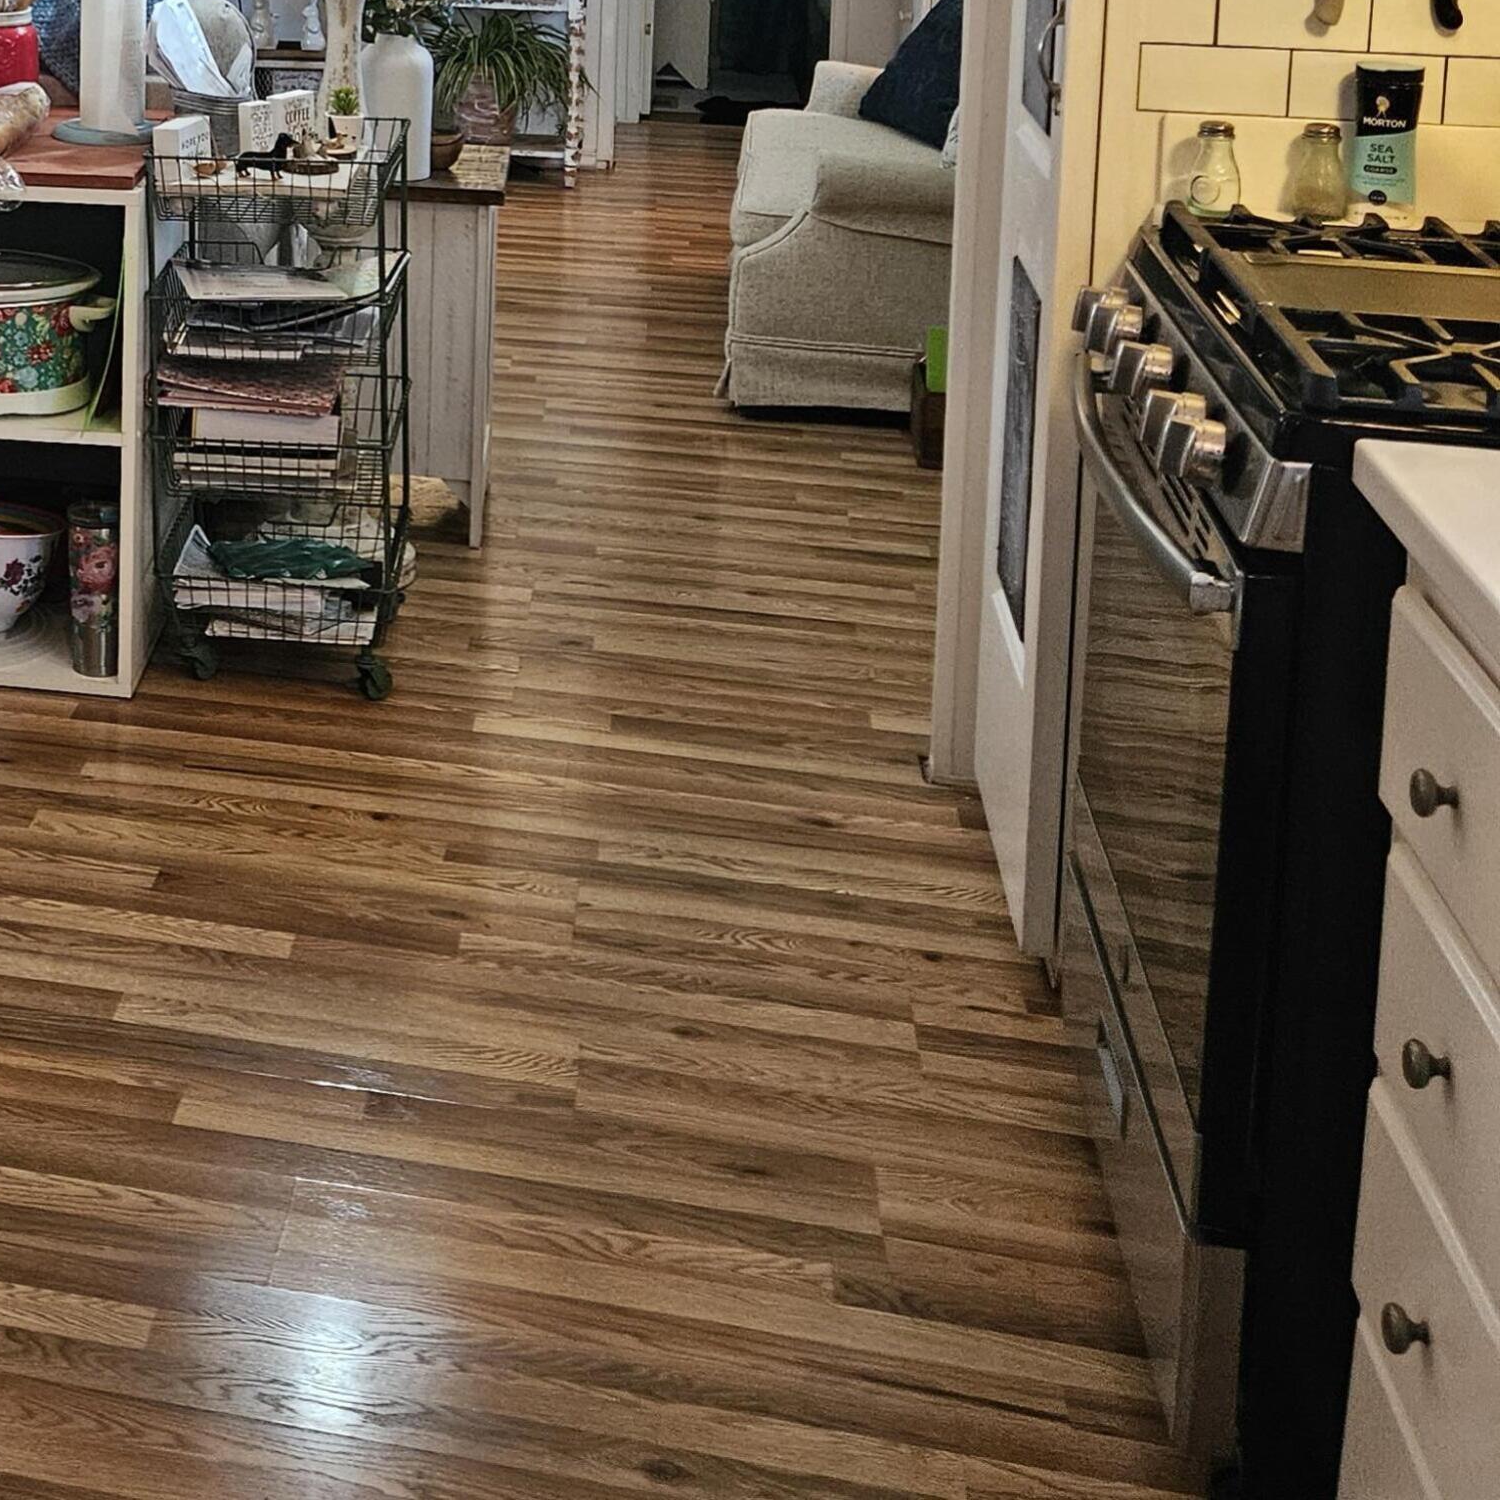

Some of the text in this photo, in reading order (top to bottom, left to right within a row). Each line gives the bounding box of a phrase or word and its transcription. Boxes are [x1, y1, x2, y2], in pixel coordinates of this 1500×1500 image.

[1363, 116, 1407, 129] MORTON
[1370, 143, 1394, 154] SEA
[1367, 153, 1396, 164] SALT
